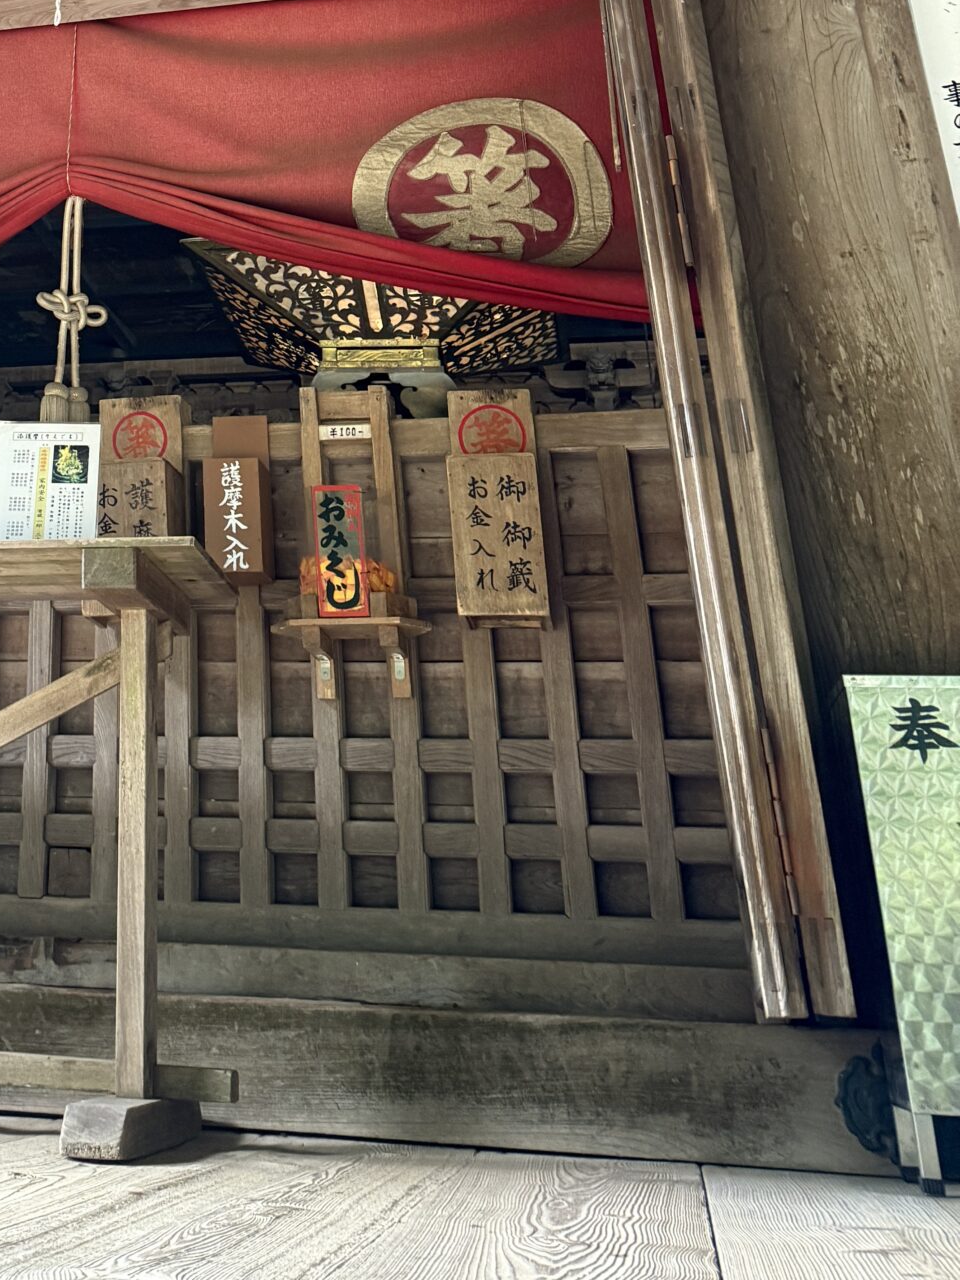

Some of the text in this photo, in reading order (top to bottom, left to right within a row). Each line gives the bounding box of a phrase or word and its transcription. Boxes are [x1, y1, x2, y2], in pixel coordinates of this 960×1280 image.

[98, 483, 120, 536] お金
[218, 460, 250, 572] 護摩木入れ
[317, 493, 361, 610] おみくじ
[465, 476, 499, 592] お金入れ
[496, 474, 538, 594] 御御籤
[889, 697, 960, 765] 奉
